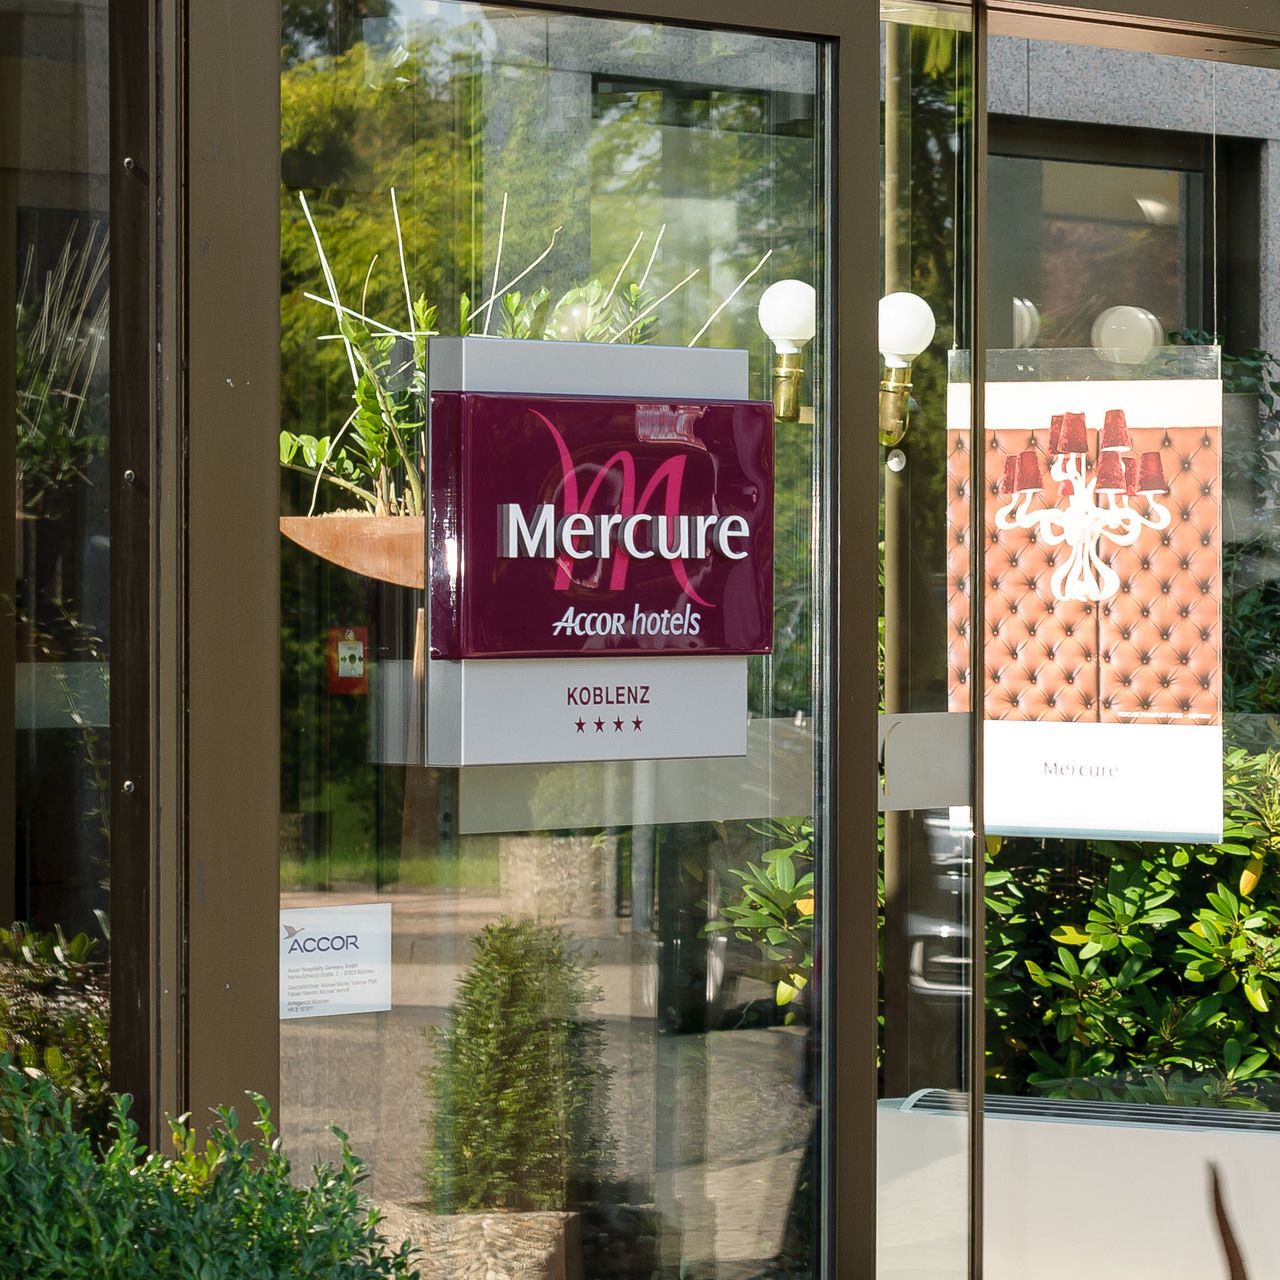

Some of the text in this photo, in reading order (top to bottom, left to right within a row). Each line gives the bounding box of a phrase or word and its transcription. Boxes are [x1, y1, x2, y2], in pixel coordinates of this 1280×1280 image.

[502, 502, 750, 561] Mercure
[631, 603, 701, 636] hotels
[567, 685, 651, 705] KOBLENZ
[288, 934, 359, 954] ACCOR
